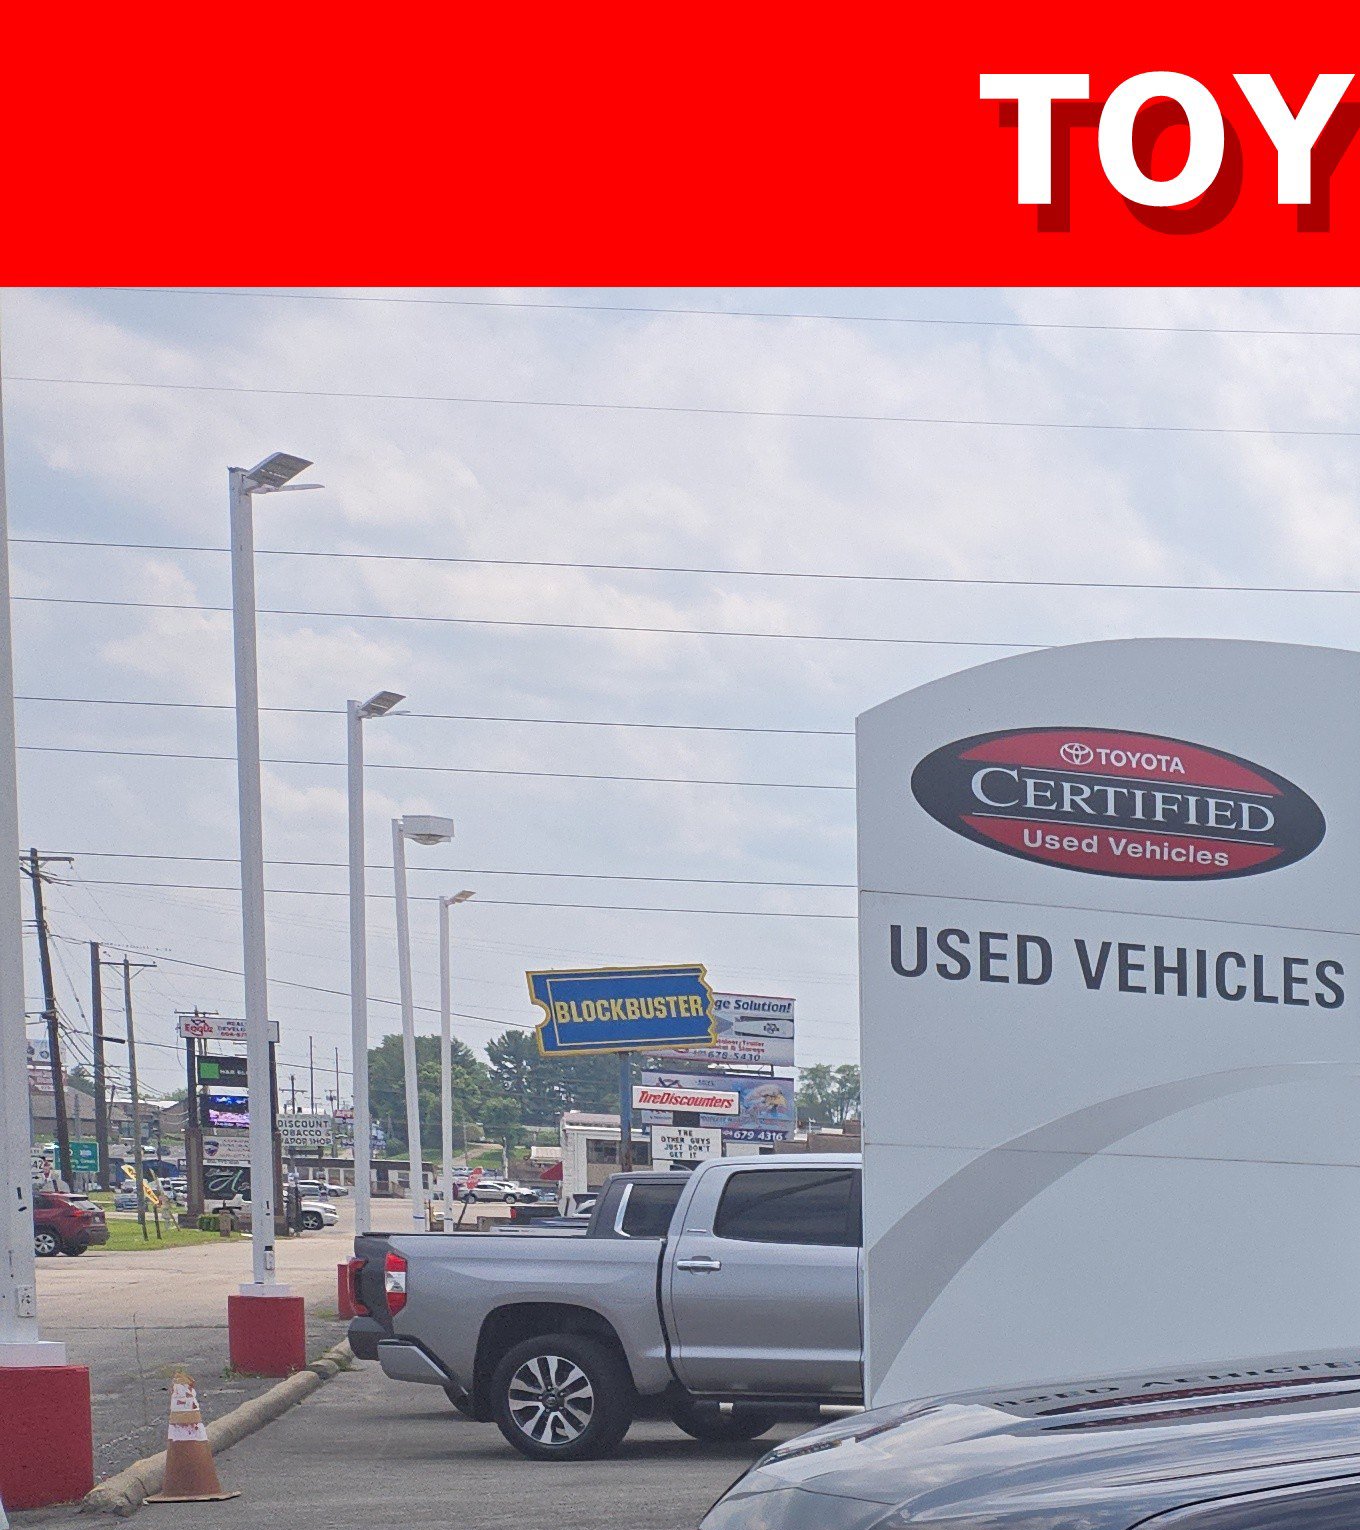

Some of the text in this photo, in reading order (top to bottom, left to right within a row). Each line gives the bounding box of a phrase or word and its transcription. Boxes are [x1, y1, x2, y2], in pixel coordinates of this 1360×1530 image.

[1096, 748, 1186, 774] TOYOTA
[970, 766, 1276, 833] CERTIFIED
[1022, 828, 1230, 867] Used Vehicles
[889, 923, 1346, 1009] USED VEHICLES
[553, 995, 704, 1024] BLOCKBUSTER
[733, 998, 792, 1014] Solution!
[638, 1090, 735, 1109] TireDiscounters
[277, 1119, 330, 1129] DISCOUNT
[660, 1136, 711, 1145] OTHER GUYS
[664, 1143, 683, 1151] JUST
[669, 1151, 698, 1159] GET IT
